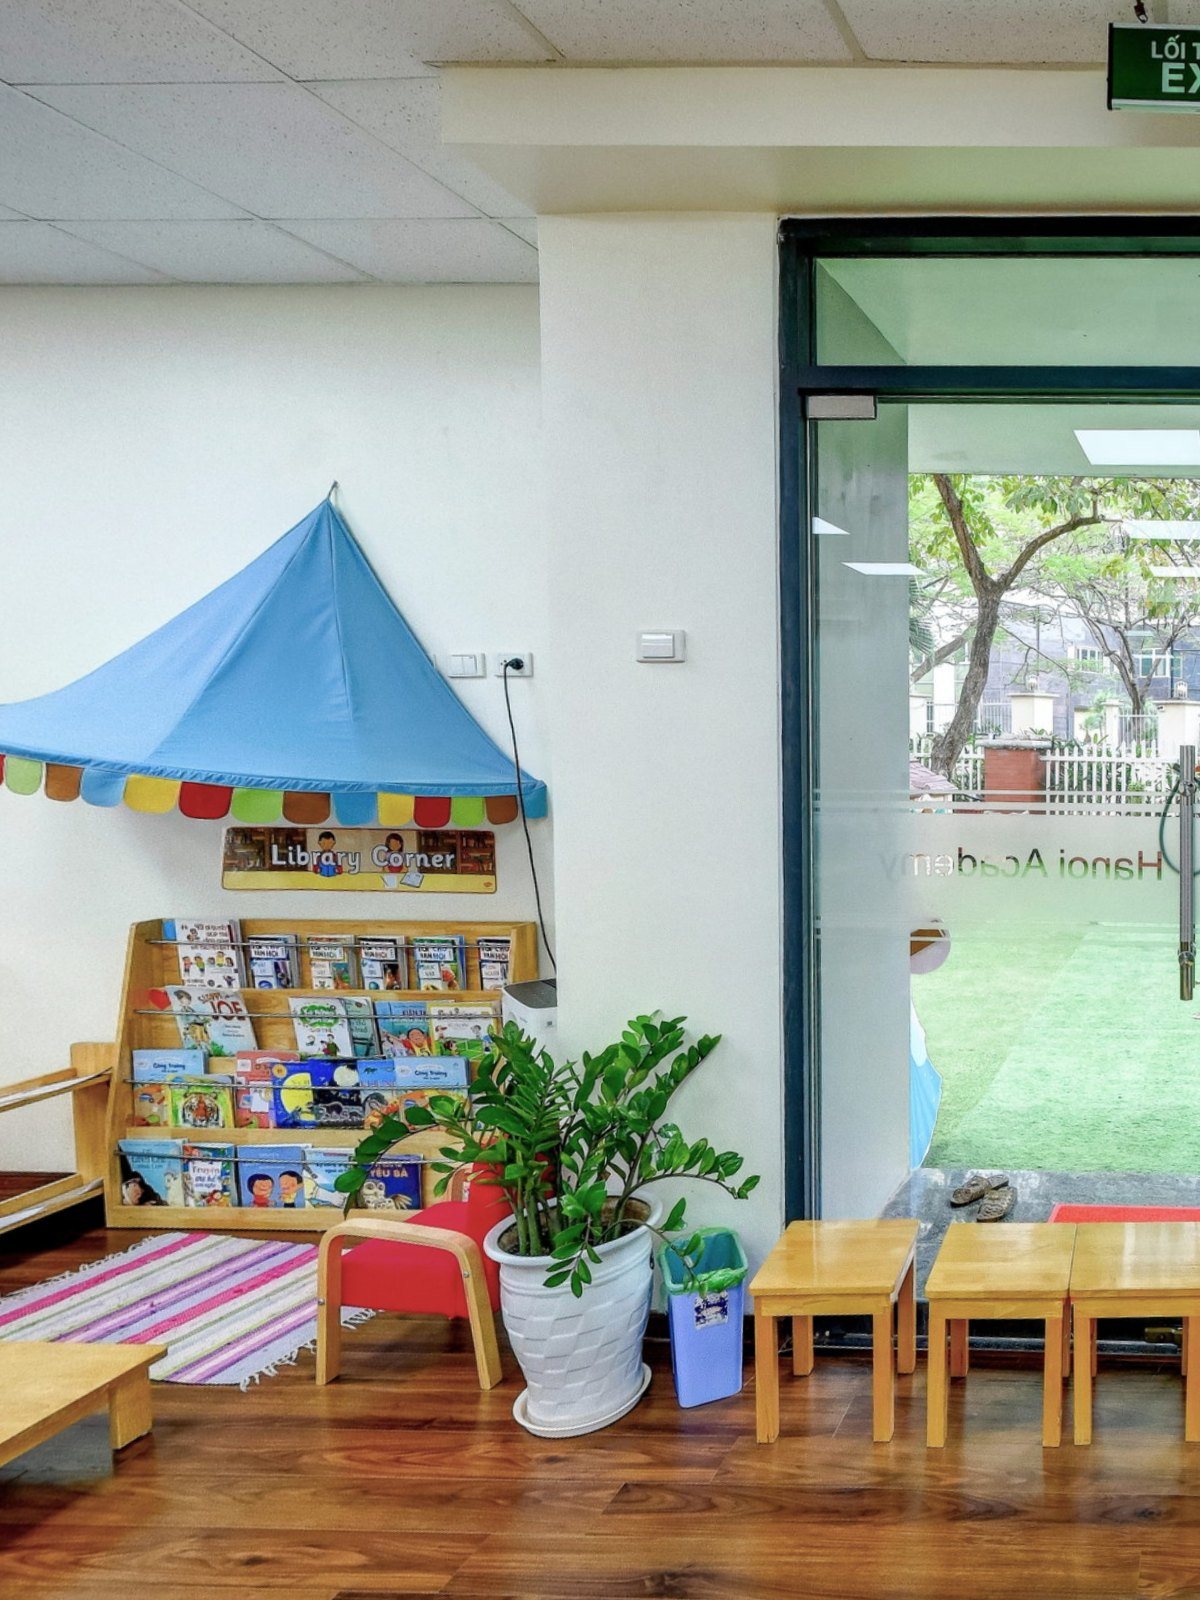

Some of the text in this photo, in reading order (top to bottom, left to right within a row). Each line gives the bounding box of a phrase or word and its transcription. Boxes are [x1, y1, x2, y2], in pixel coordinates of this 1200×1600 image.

[1151, 34, 1186, 59] LỐI
[271, 844, 455, 874] Library Corner
